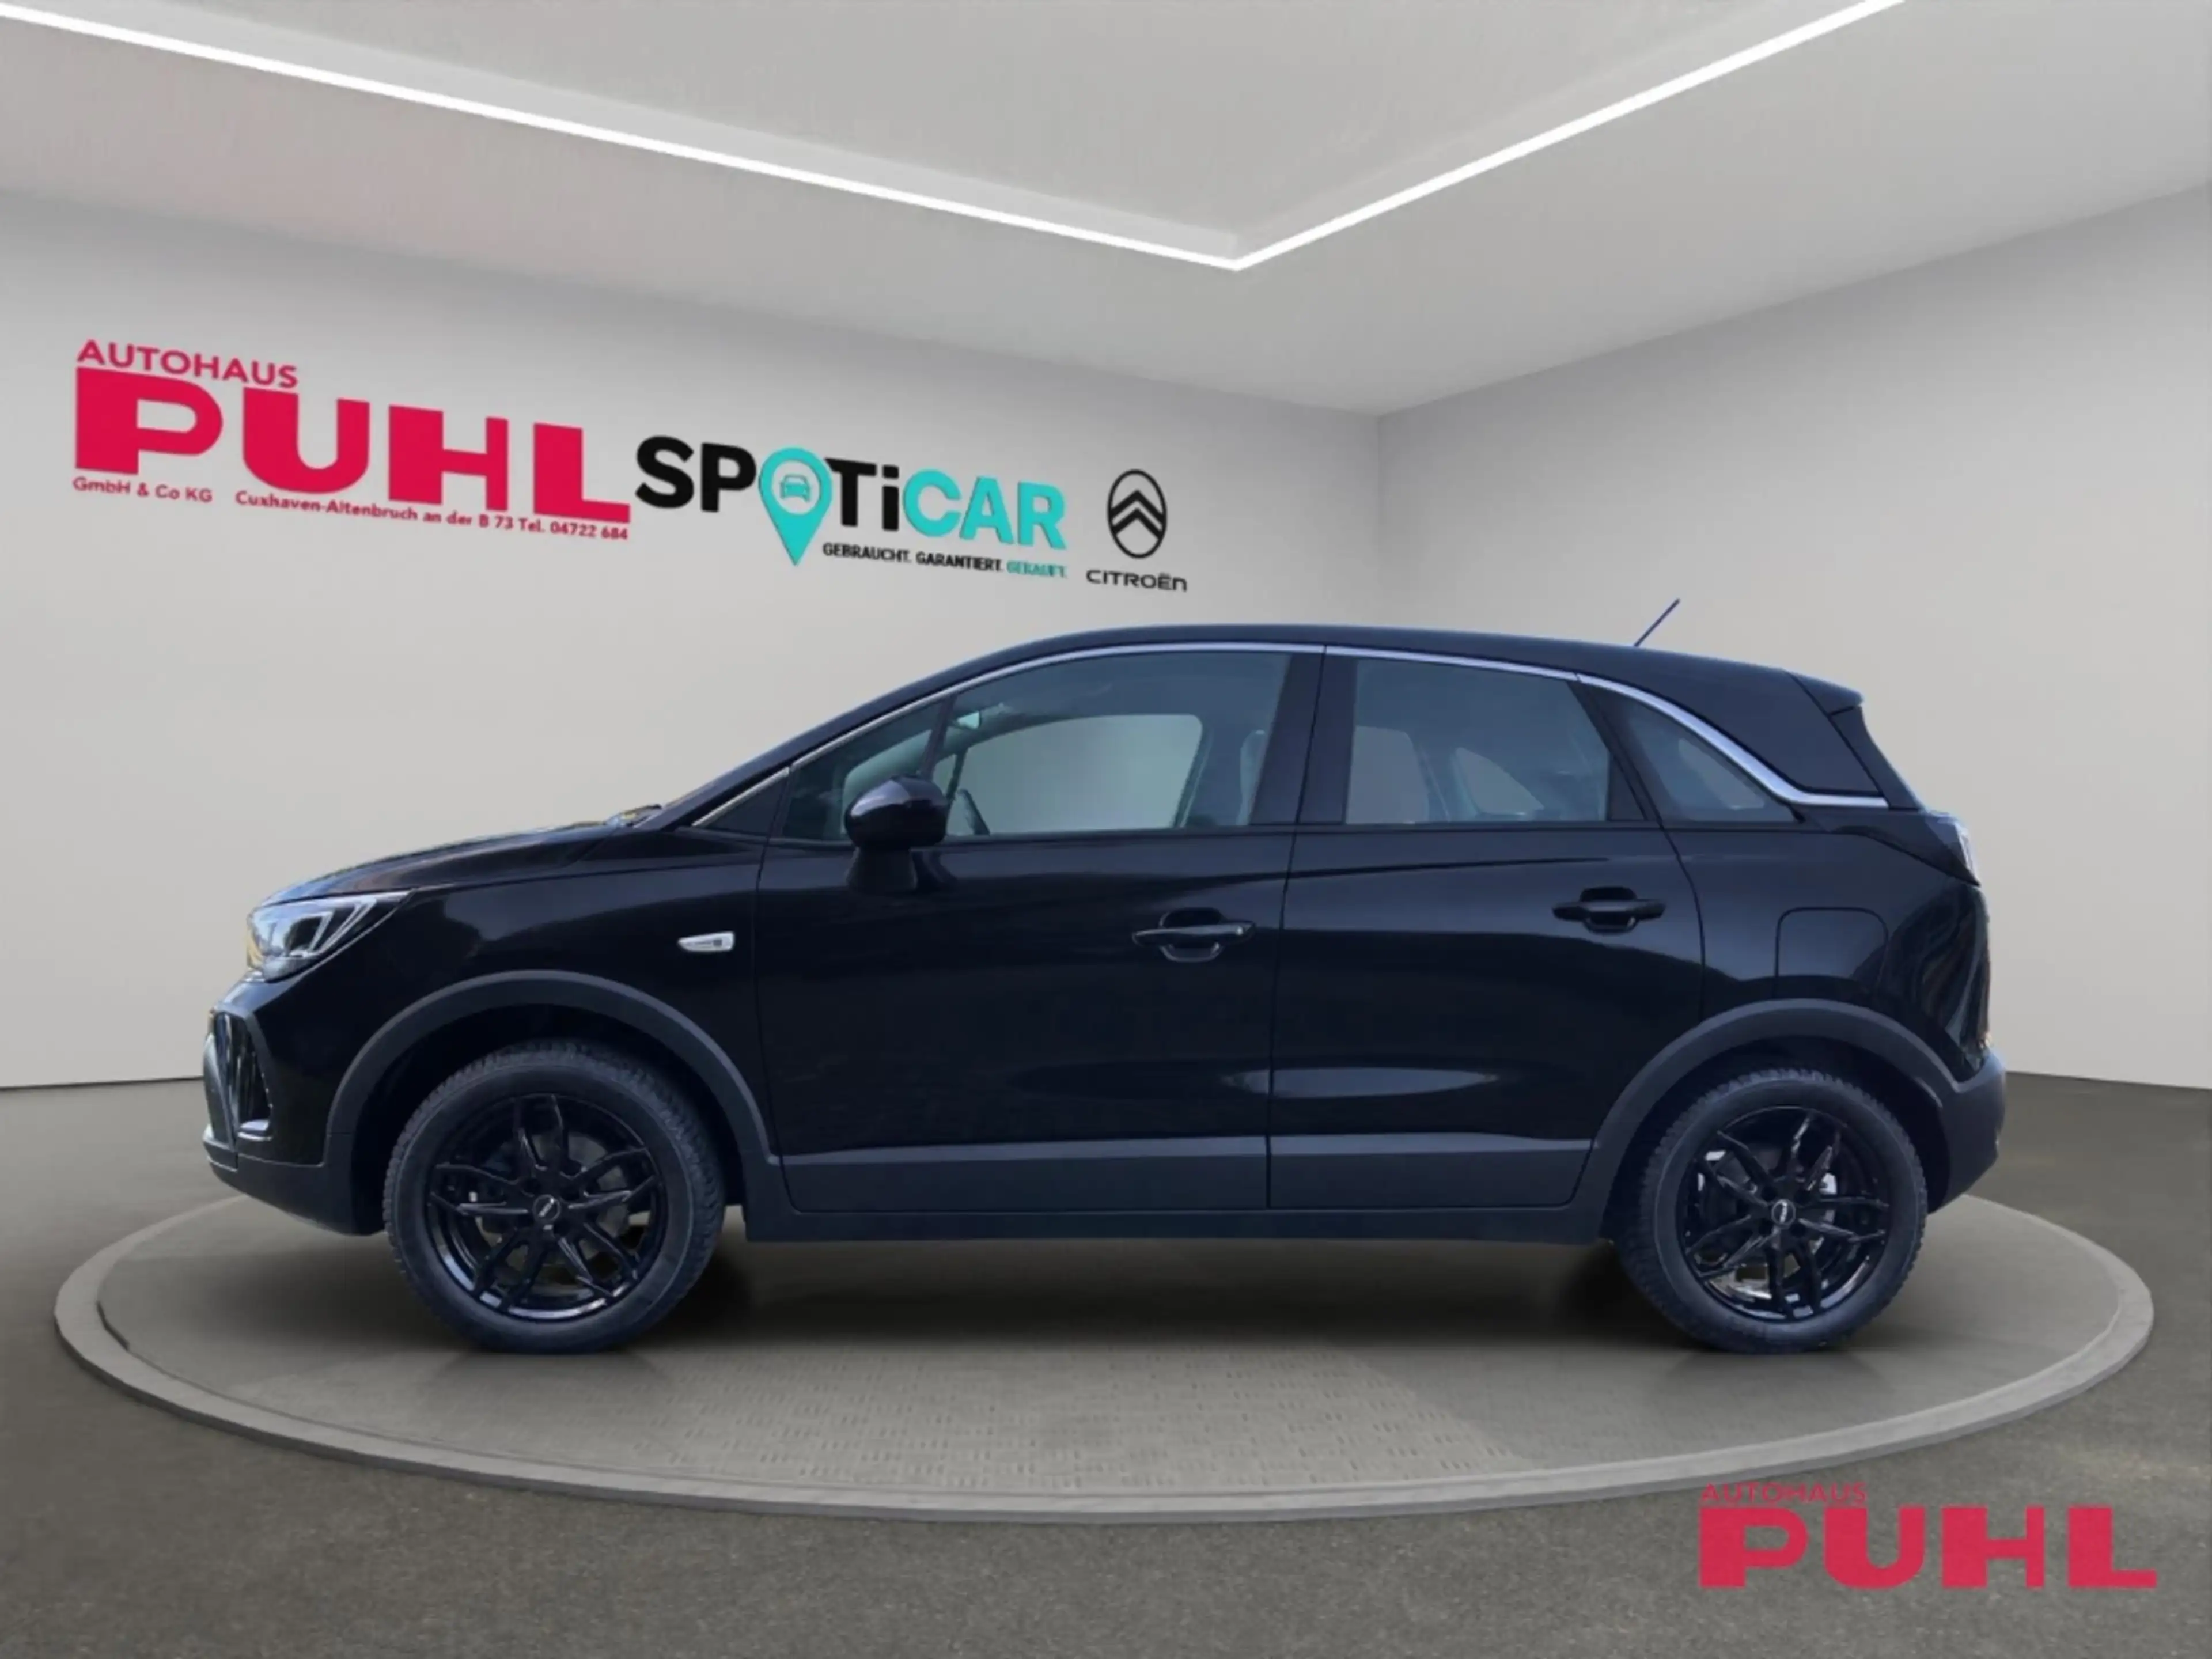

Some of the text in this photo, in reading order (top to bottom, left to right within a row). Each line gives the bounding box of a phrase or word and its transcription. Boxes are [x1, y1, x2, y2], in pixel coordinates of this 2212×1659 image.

[77, 339, 298, 388] AUTOHAUS
[75, 367, 630, 524] PUHL
[73, 476, 131, 494] GmbH
[137, 482, 149, 497] &
[154, 484, 180, 500] Co
[185, 487, 213, 503] KG
[423, 512, 441, 523] an
[446, 510, 472, 525] der
[495, 515, 513, 529] 73
[518, 518, 545, 533] Tel.
[550, 521, 596, 538] 04722
[601, 526, 628, 540] 684
